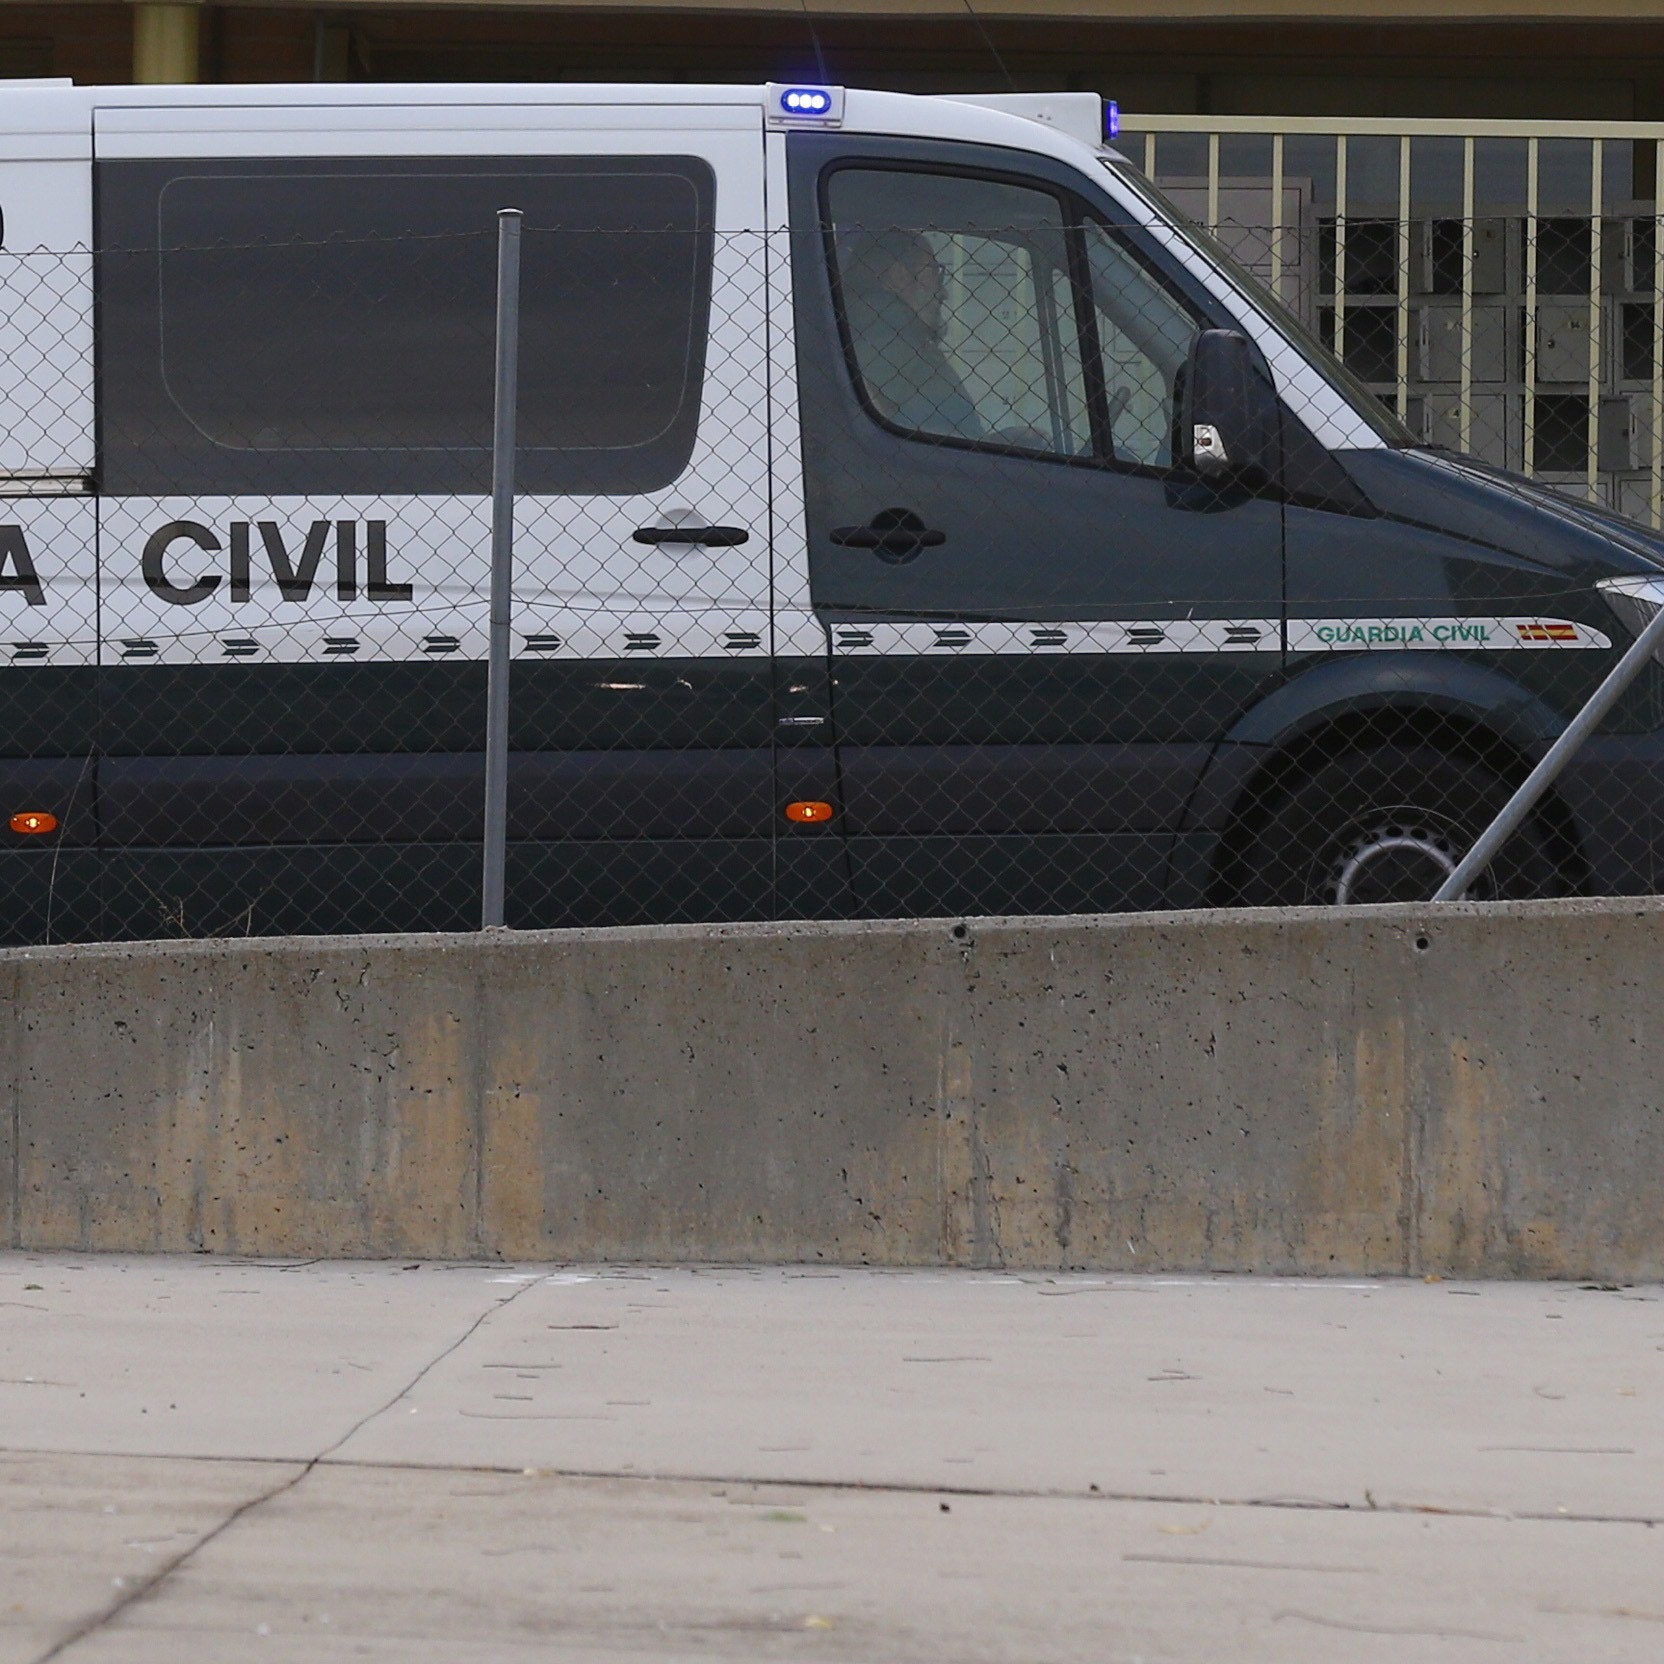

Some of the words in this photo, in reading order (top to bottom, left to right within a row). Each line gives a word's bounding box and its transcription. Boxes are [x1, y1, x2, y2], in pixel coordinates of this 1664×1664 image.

[141, 519, 414, 605] CIVIL
[1317, 625, 1424, 643] GUARDIA
[1432, 624, 1491, 642] CIVIL
